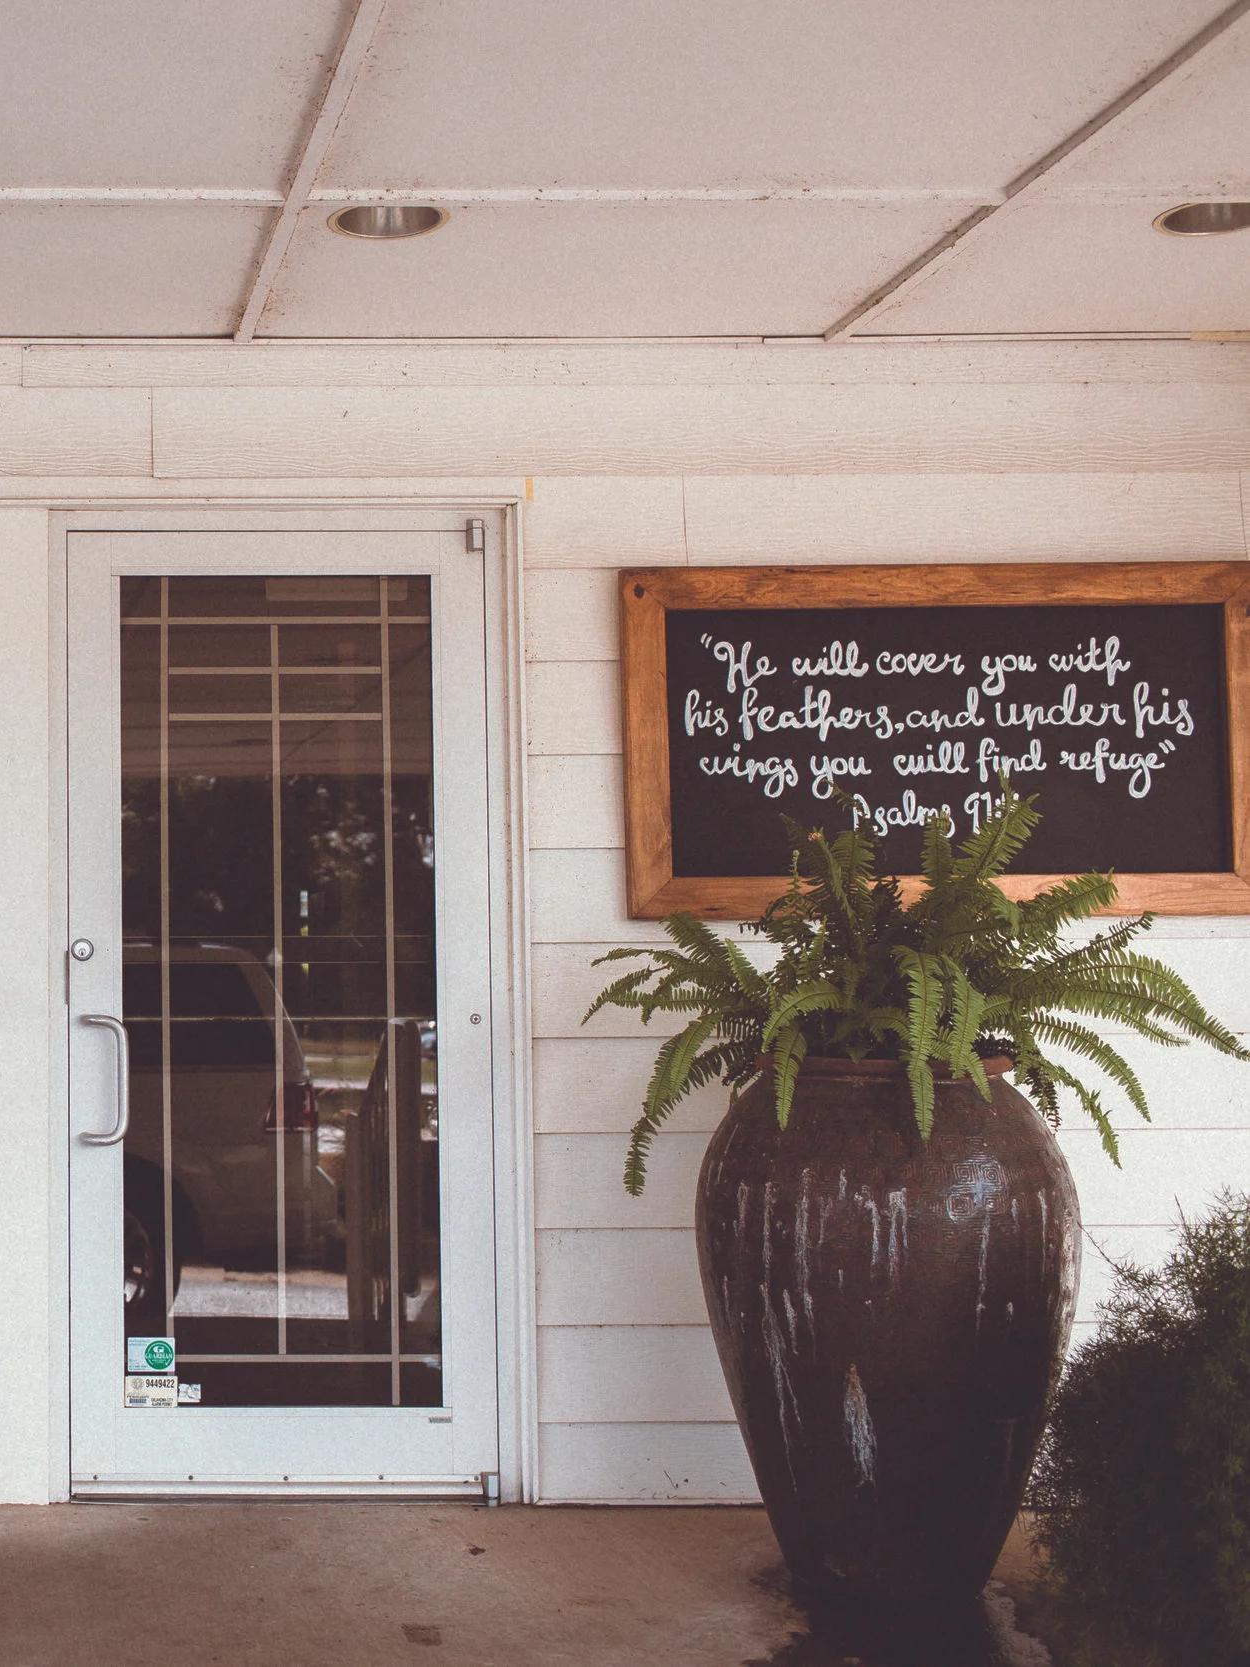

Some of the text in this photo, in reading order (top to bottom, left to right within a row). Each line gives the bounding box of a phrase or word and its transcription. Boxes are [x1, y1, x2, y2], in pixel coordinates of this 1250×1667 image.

[791, 641, 869, 677] will
[876, 652, 965, 677] cover
[981, 655, 1037, 696] you
[1049, 635, 1130, 686] with
[685, 689, 728, 737] his
[995, 684, 1126, 731] under
[1134, 682, 1194, 738] his
[700, 743, 798, 798] wings
[810, 755, 871, 799] you
[893, 741, 969, 776] will
[976, 738, 1047, 783] find
[145, 1379, 175, 1388] 9449422
